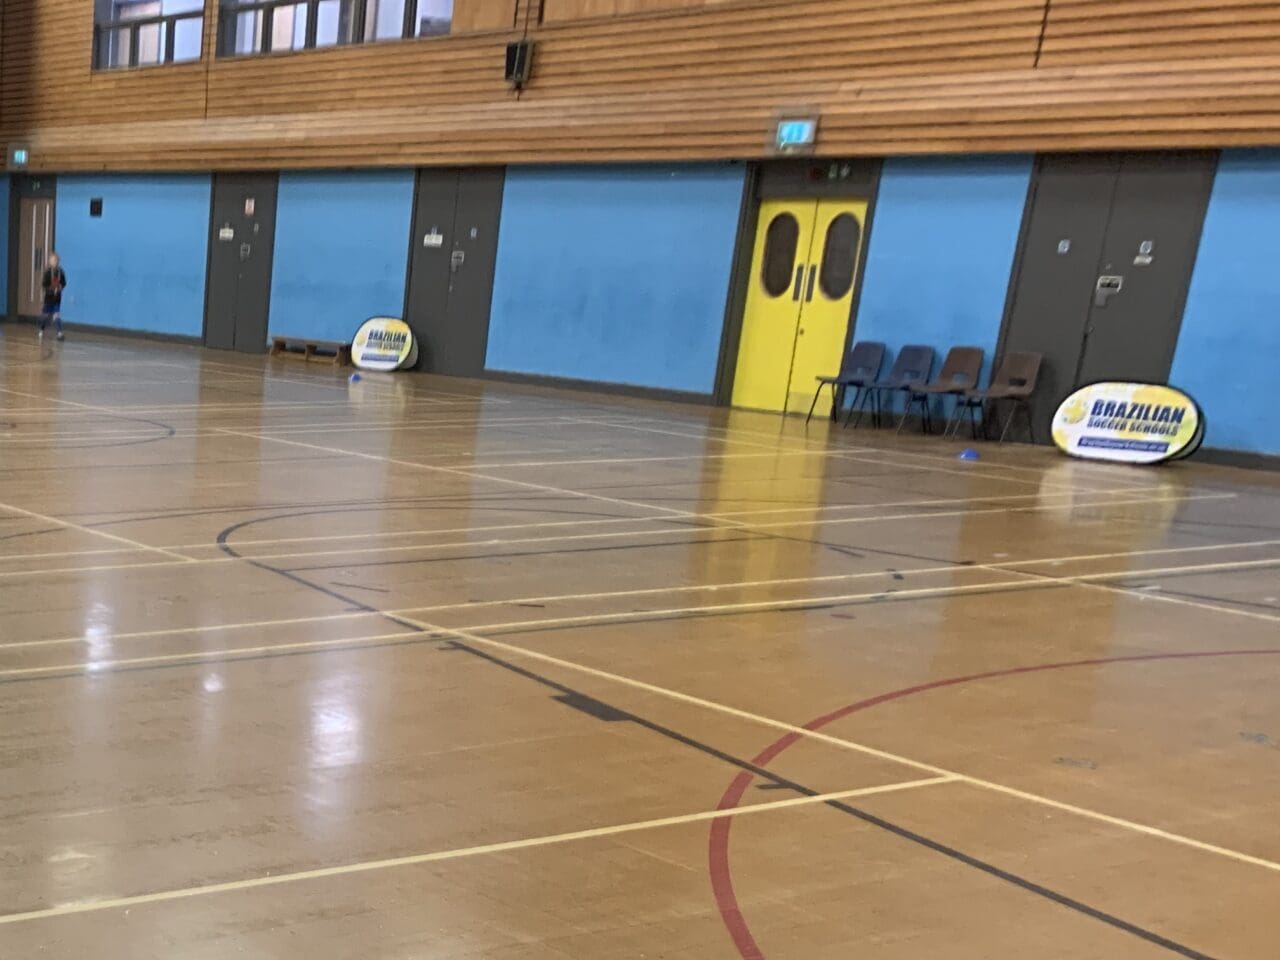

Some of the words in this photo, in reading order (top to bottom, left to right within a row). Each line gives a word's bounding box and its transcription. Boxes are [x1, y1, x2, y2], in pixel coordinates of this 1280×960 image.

[368, 329, 407, 342] BRAZILIAN
[1091, 399, 1186, 424] BRAZILIAN
[1087, 417, 1127, 432] SOCCER
[1129, 420, 1180, 436] SCHOOLS
